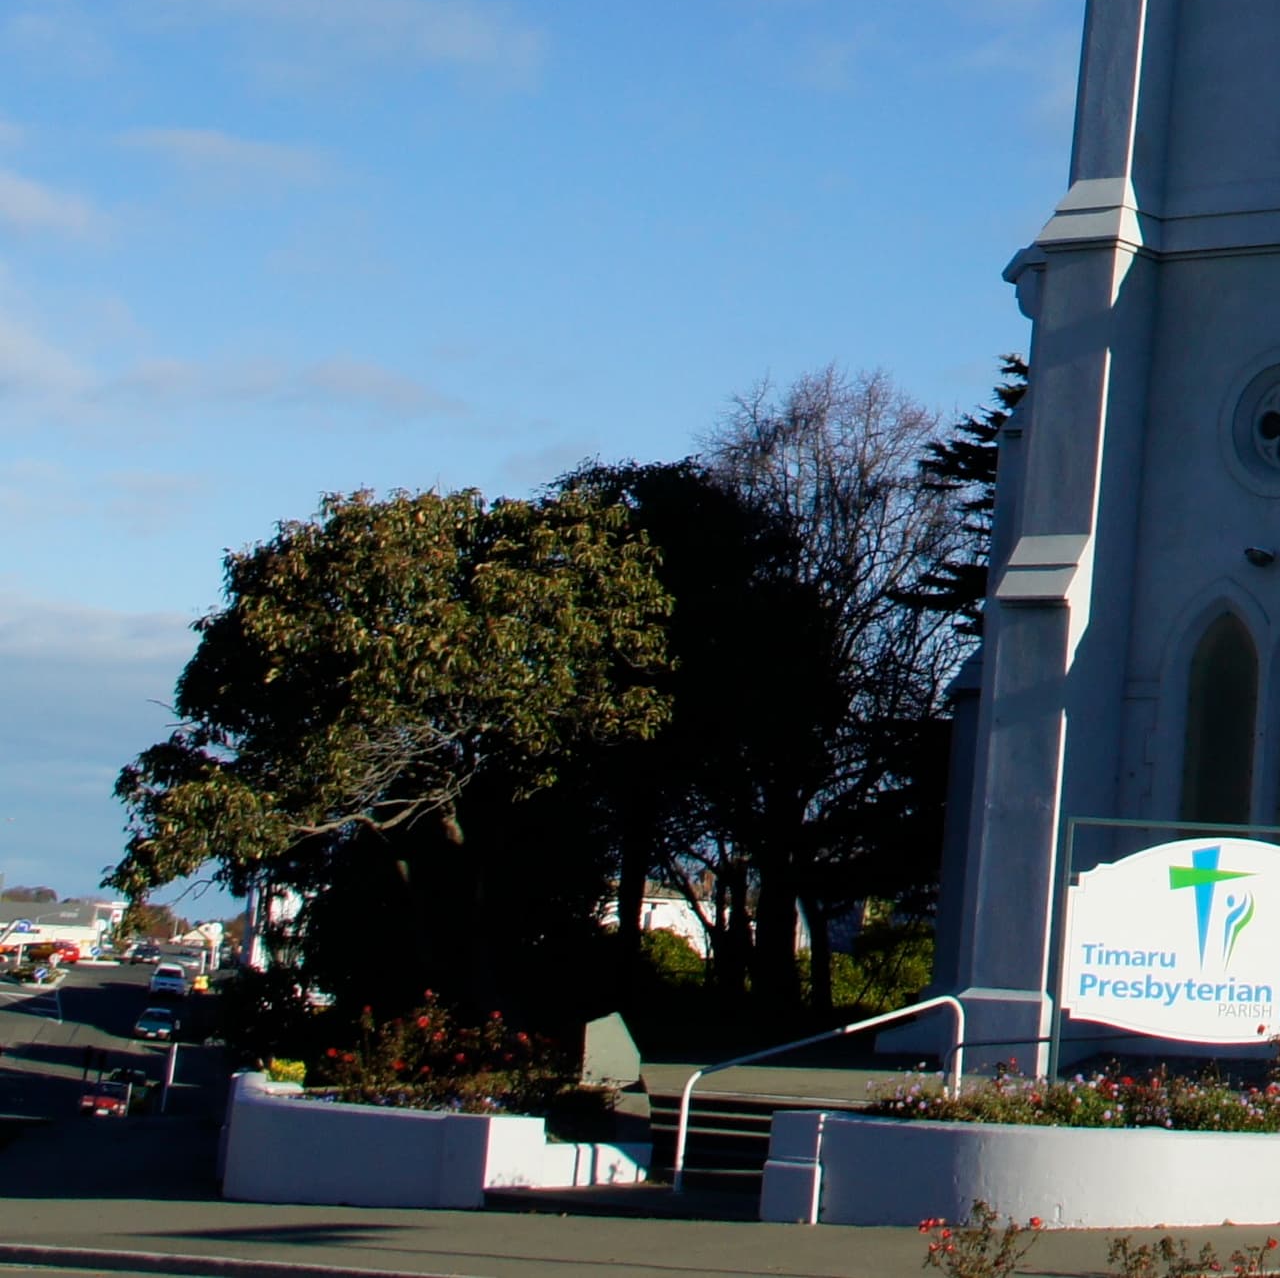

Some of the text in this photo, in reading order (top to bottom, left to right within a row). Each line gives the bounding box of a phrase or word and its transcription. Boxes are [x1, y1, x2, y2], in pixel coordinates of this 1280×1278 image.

[1081, 943, 1177, 968] Timaru
[1079, 973, 1272, 1007] Presbyterian
[1217, 1003, 1272, 1018] PARISH
